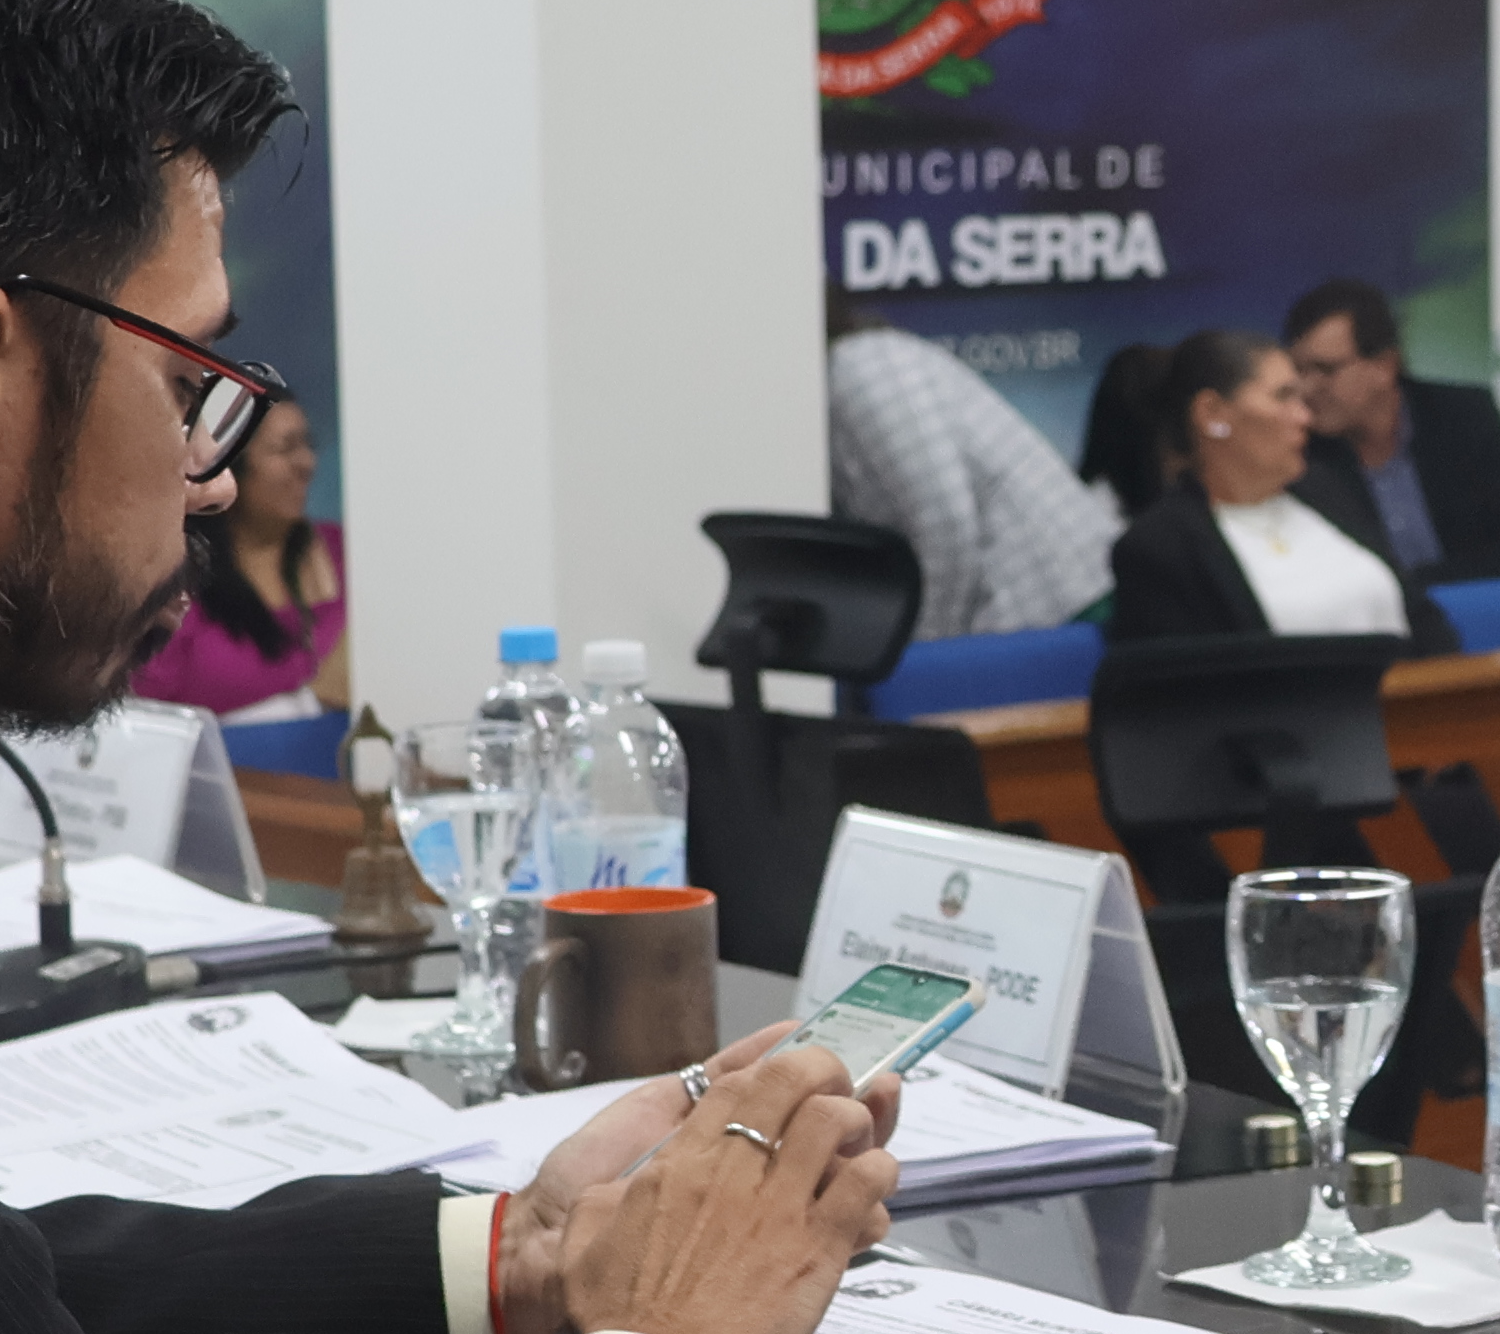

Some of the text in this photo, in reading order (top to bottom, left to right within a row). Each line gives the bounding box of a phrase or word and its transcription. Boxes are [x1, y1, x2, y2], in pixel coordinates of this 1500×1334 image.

[822, 144, 1165, 198] UNICIPAL DE
[842, 210, 1168, 292] DA SERRA
[985, 964, 1041, 1005] PODE
